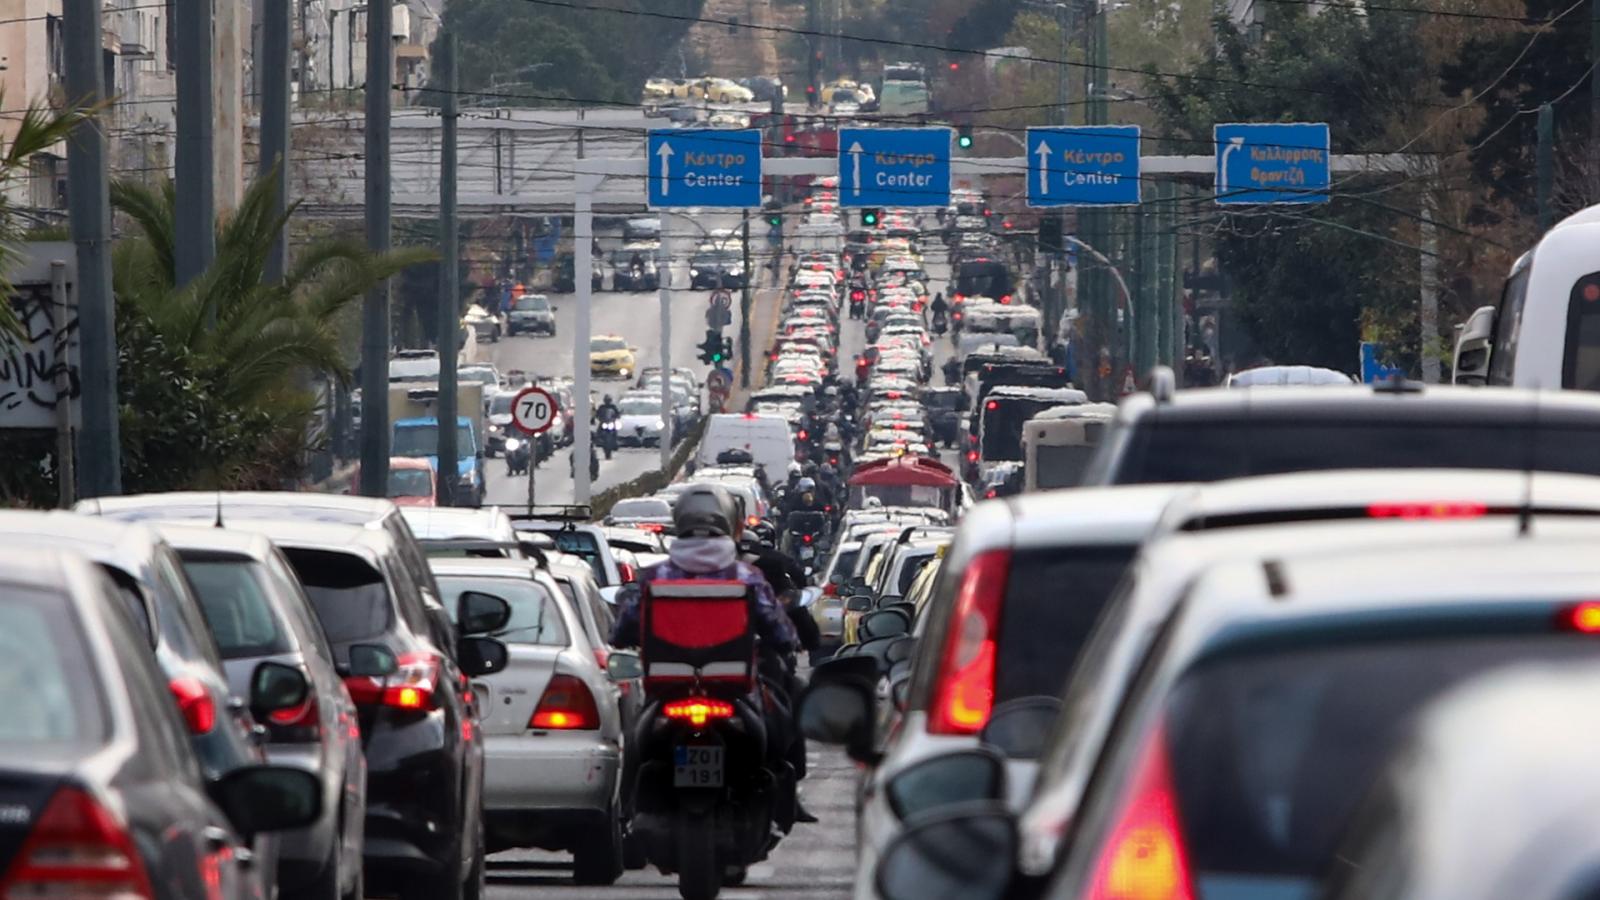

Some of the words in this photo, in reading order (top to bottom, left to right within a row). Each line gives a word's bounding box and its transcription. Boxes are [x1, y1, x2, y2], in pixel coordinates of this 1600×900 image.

[684, 151, 745, 168] Κέντρο
[1064, 149, 1124, 166] Κέντρο
[684, 172, 743, 187] Center
[876, 172, 933, 186] Center
[1064, 170, 1121, 186] Center
[521, 401, 547, 419] 70
[687, 769, 721, 784] 191
